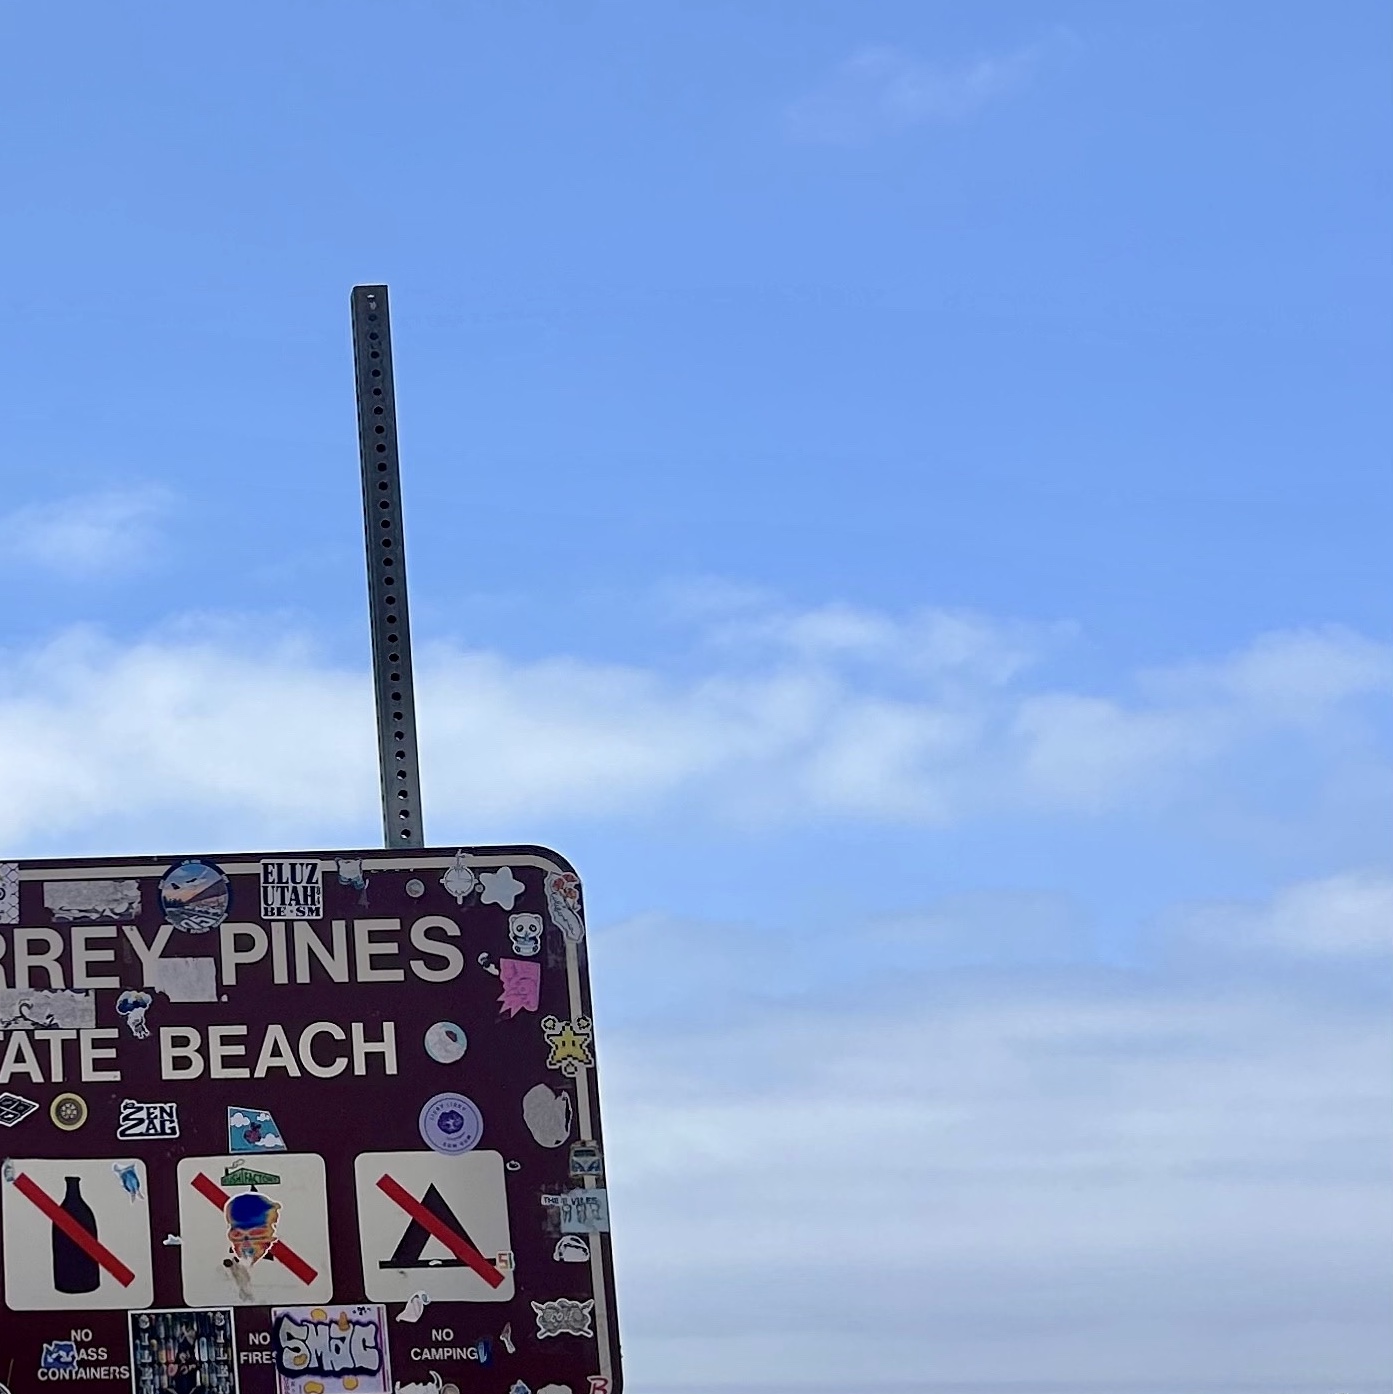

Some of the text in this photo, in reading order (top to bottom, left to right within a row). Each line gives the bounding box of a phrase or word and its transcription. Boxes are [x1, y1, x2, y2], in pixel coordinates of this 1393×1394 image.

[262, 886, 316, 906] UTAH
[220, 916, 464, 985] PINES
[160, 1021, 398, 1079] BEACH
[70, 1328, 93, 1342] NO
[248, 1332, 271, 1346] NO
[431, 1328, 454, 1342] NO
[410, 1346, 478, 1361] CAMPING
[37, 1365, 130, 1381] CONTAINERS
